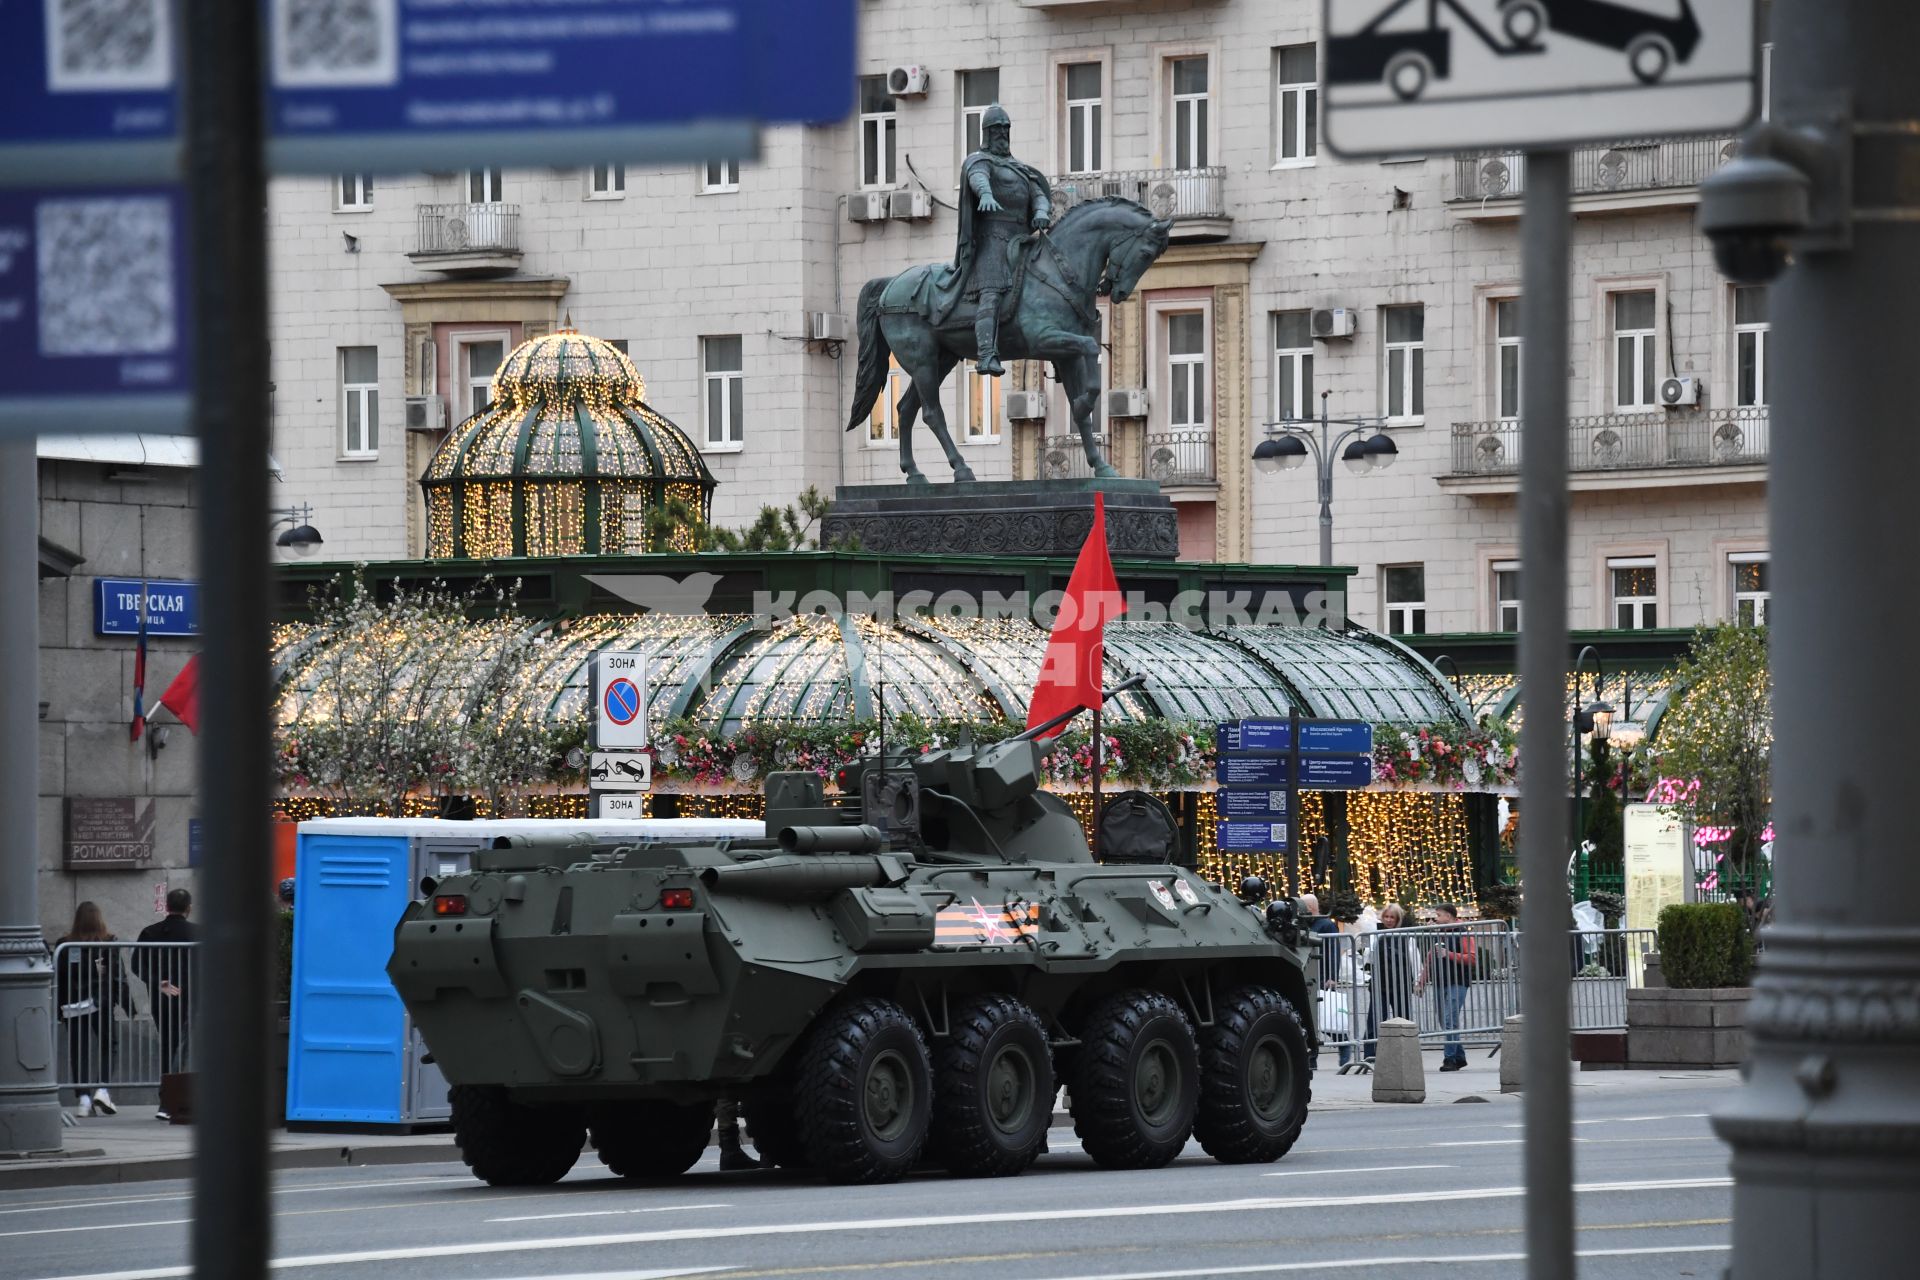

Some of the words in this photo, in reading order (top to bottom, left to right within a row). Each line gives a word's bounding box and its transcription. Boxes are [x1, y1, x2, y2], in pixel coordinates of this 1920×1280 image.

[117, 593, 184, 612] ТВЕРСКАЯ
[136, 615, 165, 625] УИЦА
[609, 658, 636, 669] ЗОНА
[610, 800, 633, 810] ЗОНА
[73, 844, 151, 859] РОТМИСТРОВ
